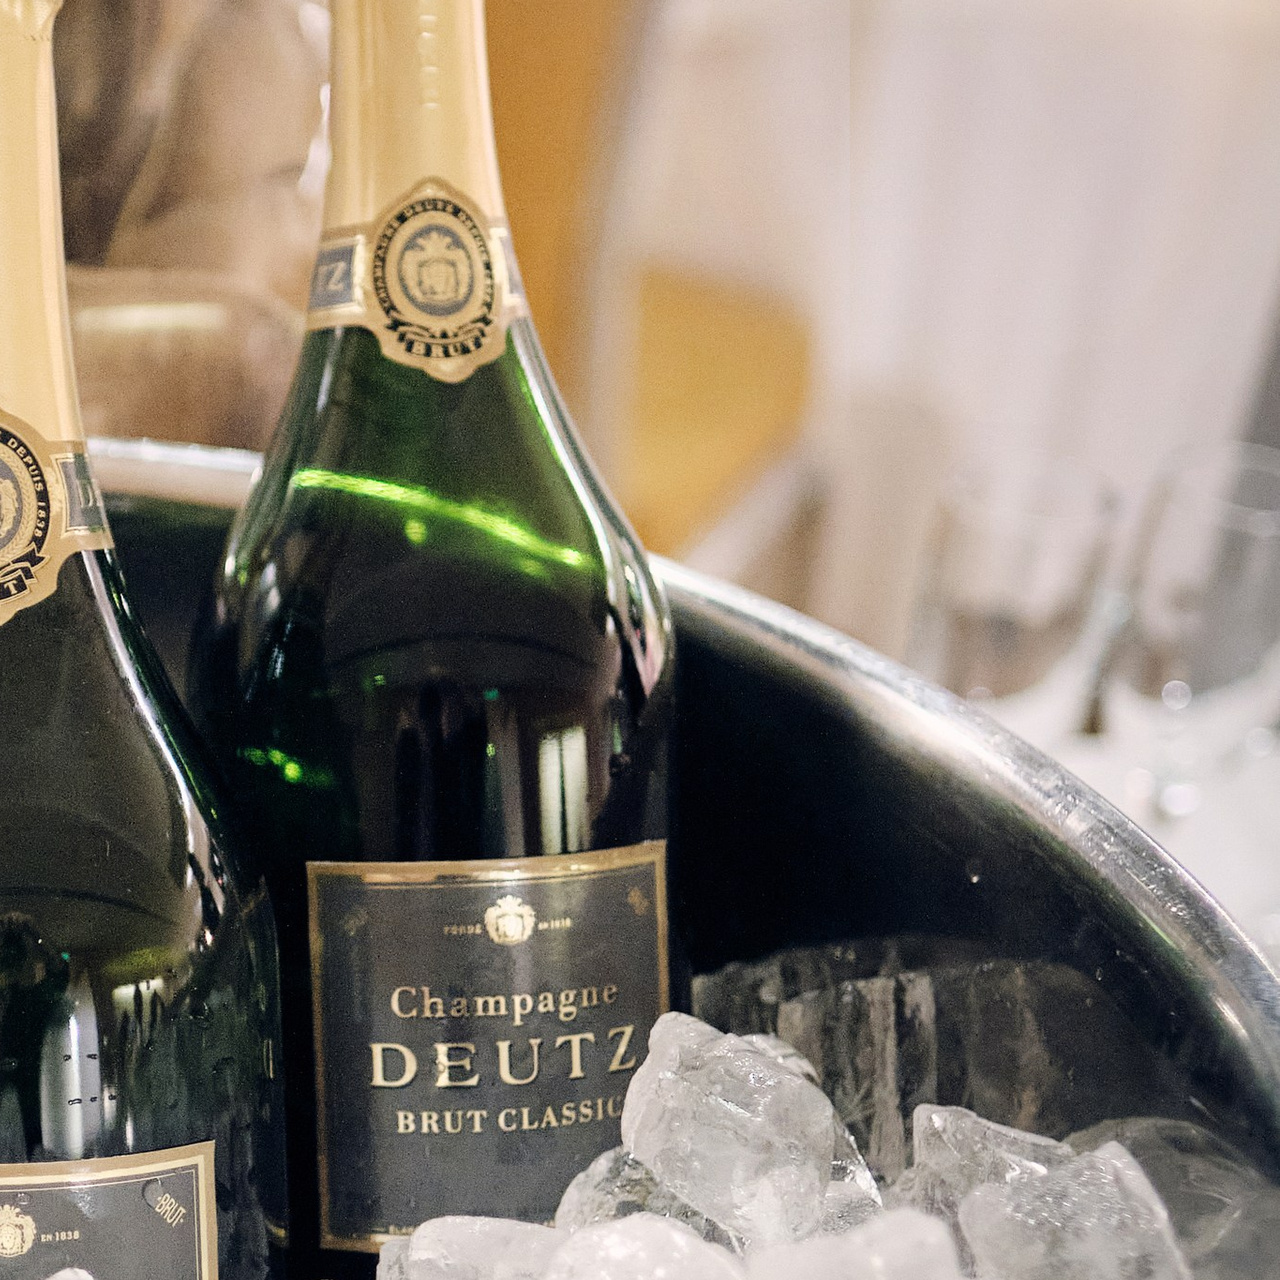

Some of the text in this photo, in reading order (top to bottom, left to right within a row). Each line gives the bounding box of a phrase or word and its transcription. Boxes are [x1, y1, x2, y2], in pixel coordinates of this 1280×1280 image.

[7, 438, 44, 492] DEPUIS
[33, 501, 47, 538] 1838
[390, 982, 618, 1026] Champagne
[370, 1024, 637, 1088] DEUTZ
[397, 1110, 487, 1134] BRUT
[155, 1192, 187, 1228] BRUT
[41, 1234, 53, 1242] EN
[55, 1230, 80, 1241] 1838
